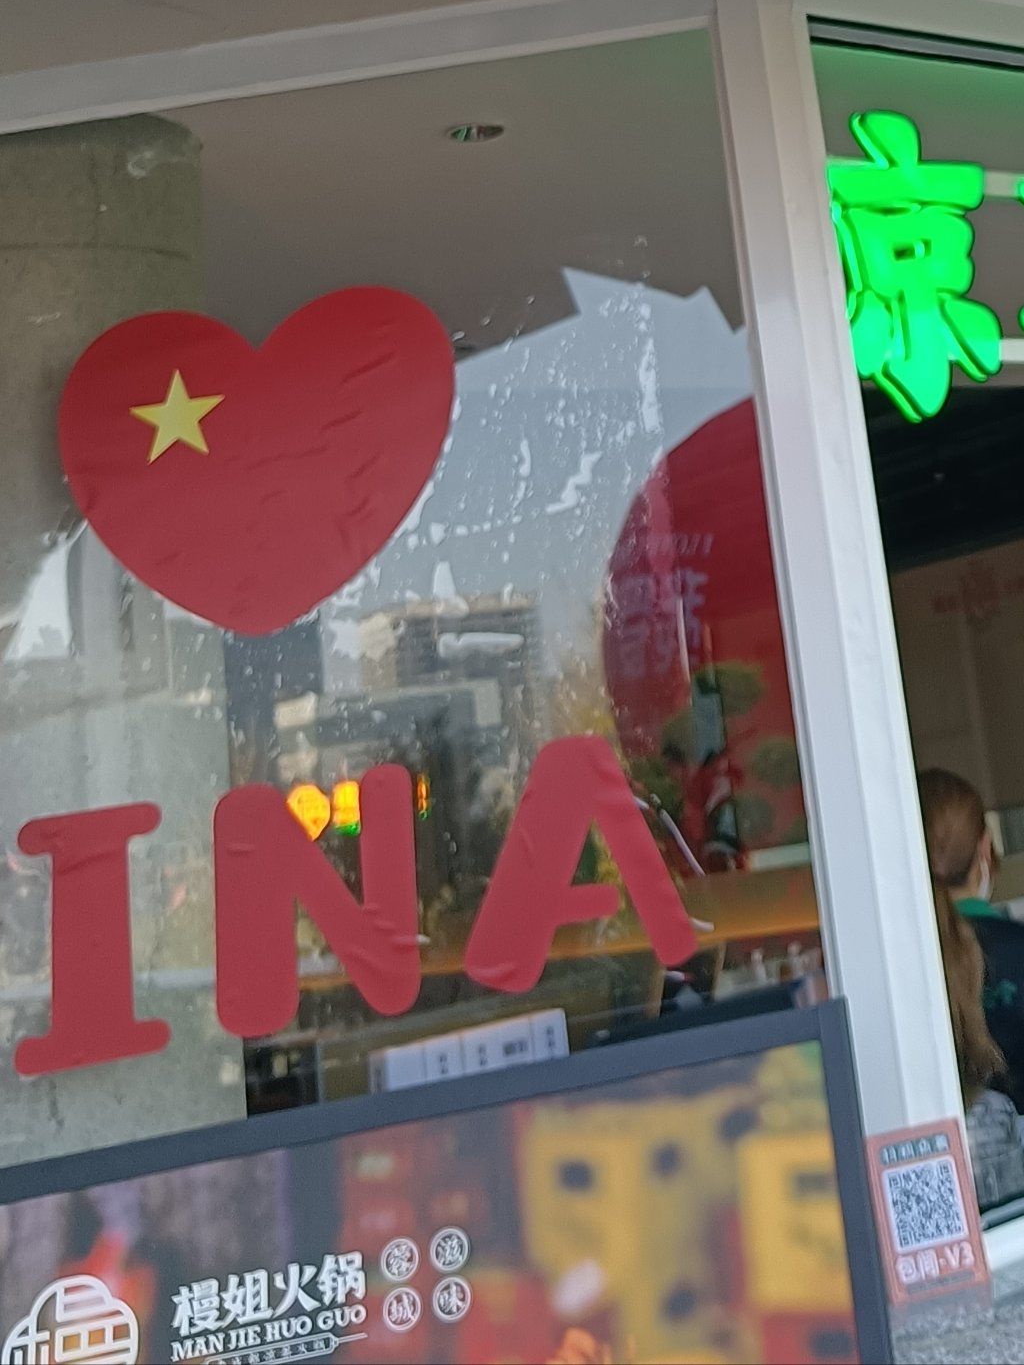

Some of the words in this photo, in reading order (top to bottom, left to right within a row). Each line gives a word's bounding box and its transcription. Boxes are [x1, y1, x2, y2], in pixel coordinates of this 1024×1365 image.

[170, 1332, 226, 1362] MAN
[227, 1327, 262, 1351] JIE
[264, 1314, 313, 1343] HUO
[316, 1303, 367, 1331] GUO
